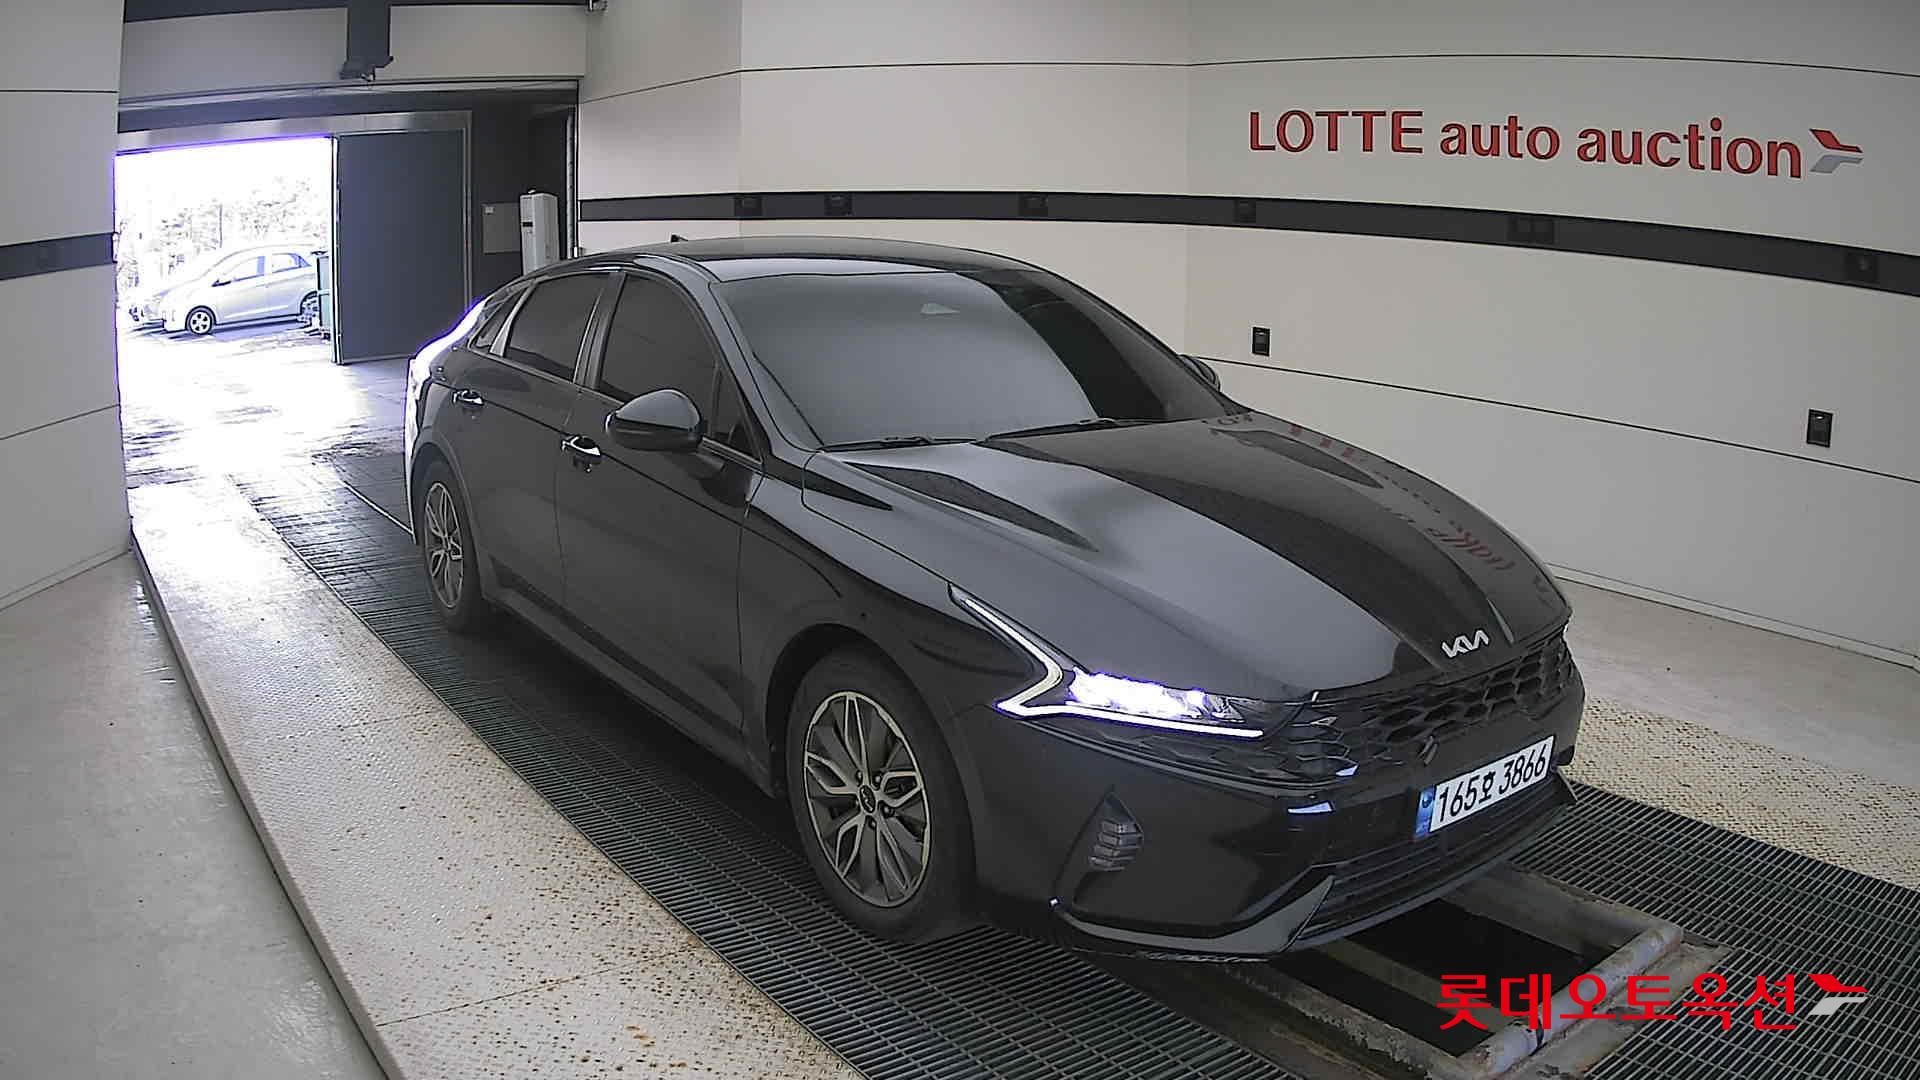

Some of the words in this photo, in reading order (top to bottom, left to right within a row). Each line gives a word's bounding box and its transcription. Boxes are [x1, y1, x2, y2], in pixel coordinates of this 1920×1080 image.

[1249, 111, 1423, 154] LOTTE
[1440, 115, 1561, 160] auto
[1576, 117, 1802, 179] auction
[1498, 744, 1548, 794] 3866
